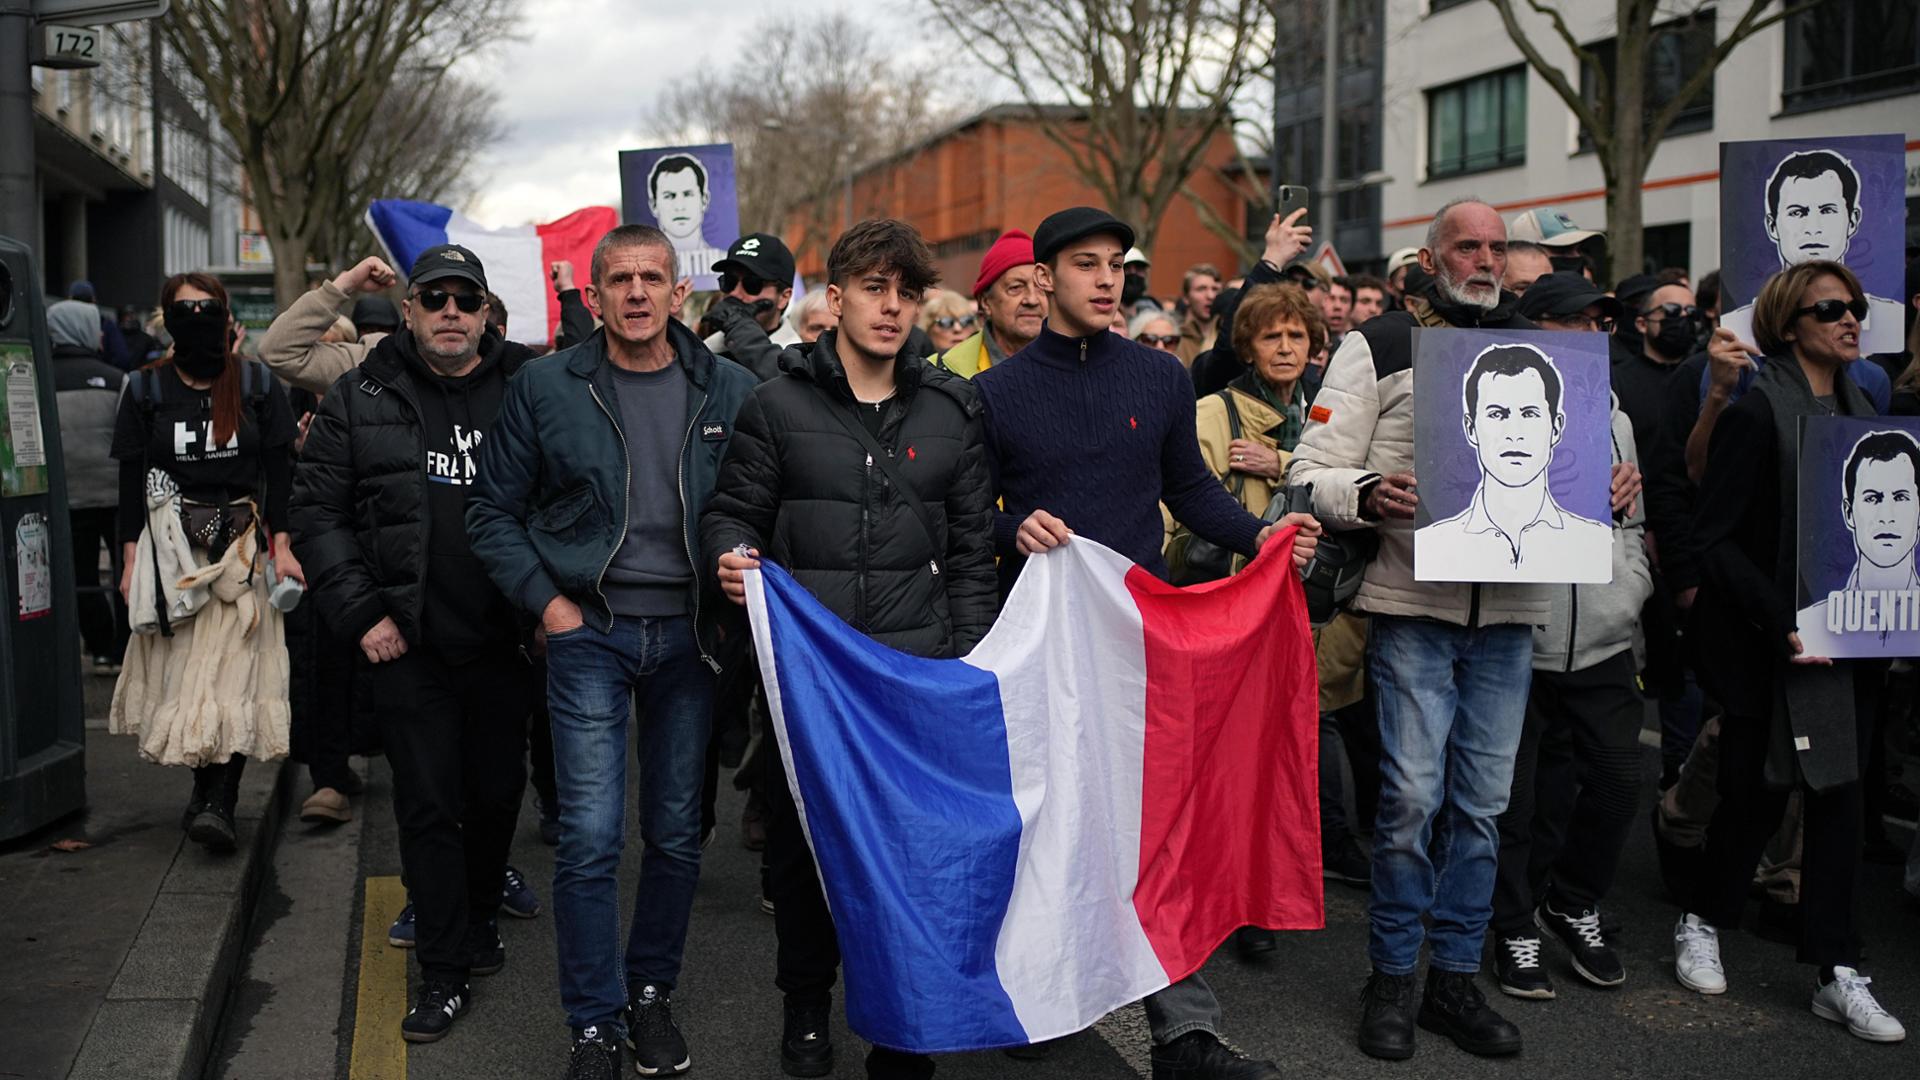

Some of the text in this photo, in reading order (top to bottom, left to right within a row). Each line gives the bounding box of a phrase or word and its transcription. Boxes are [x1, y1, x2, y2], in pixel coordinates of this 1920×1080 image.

[56, 32, 94, 58] 172
[175, 453, 200, 462] HELL
[1827, 590, 1920, 634] QUENTI
